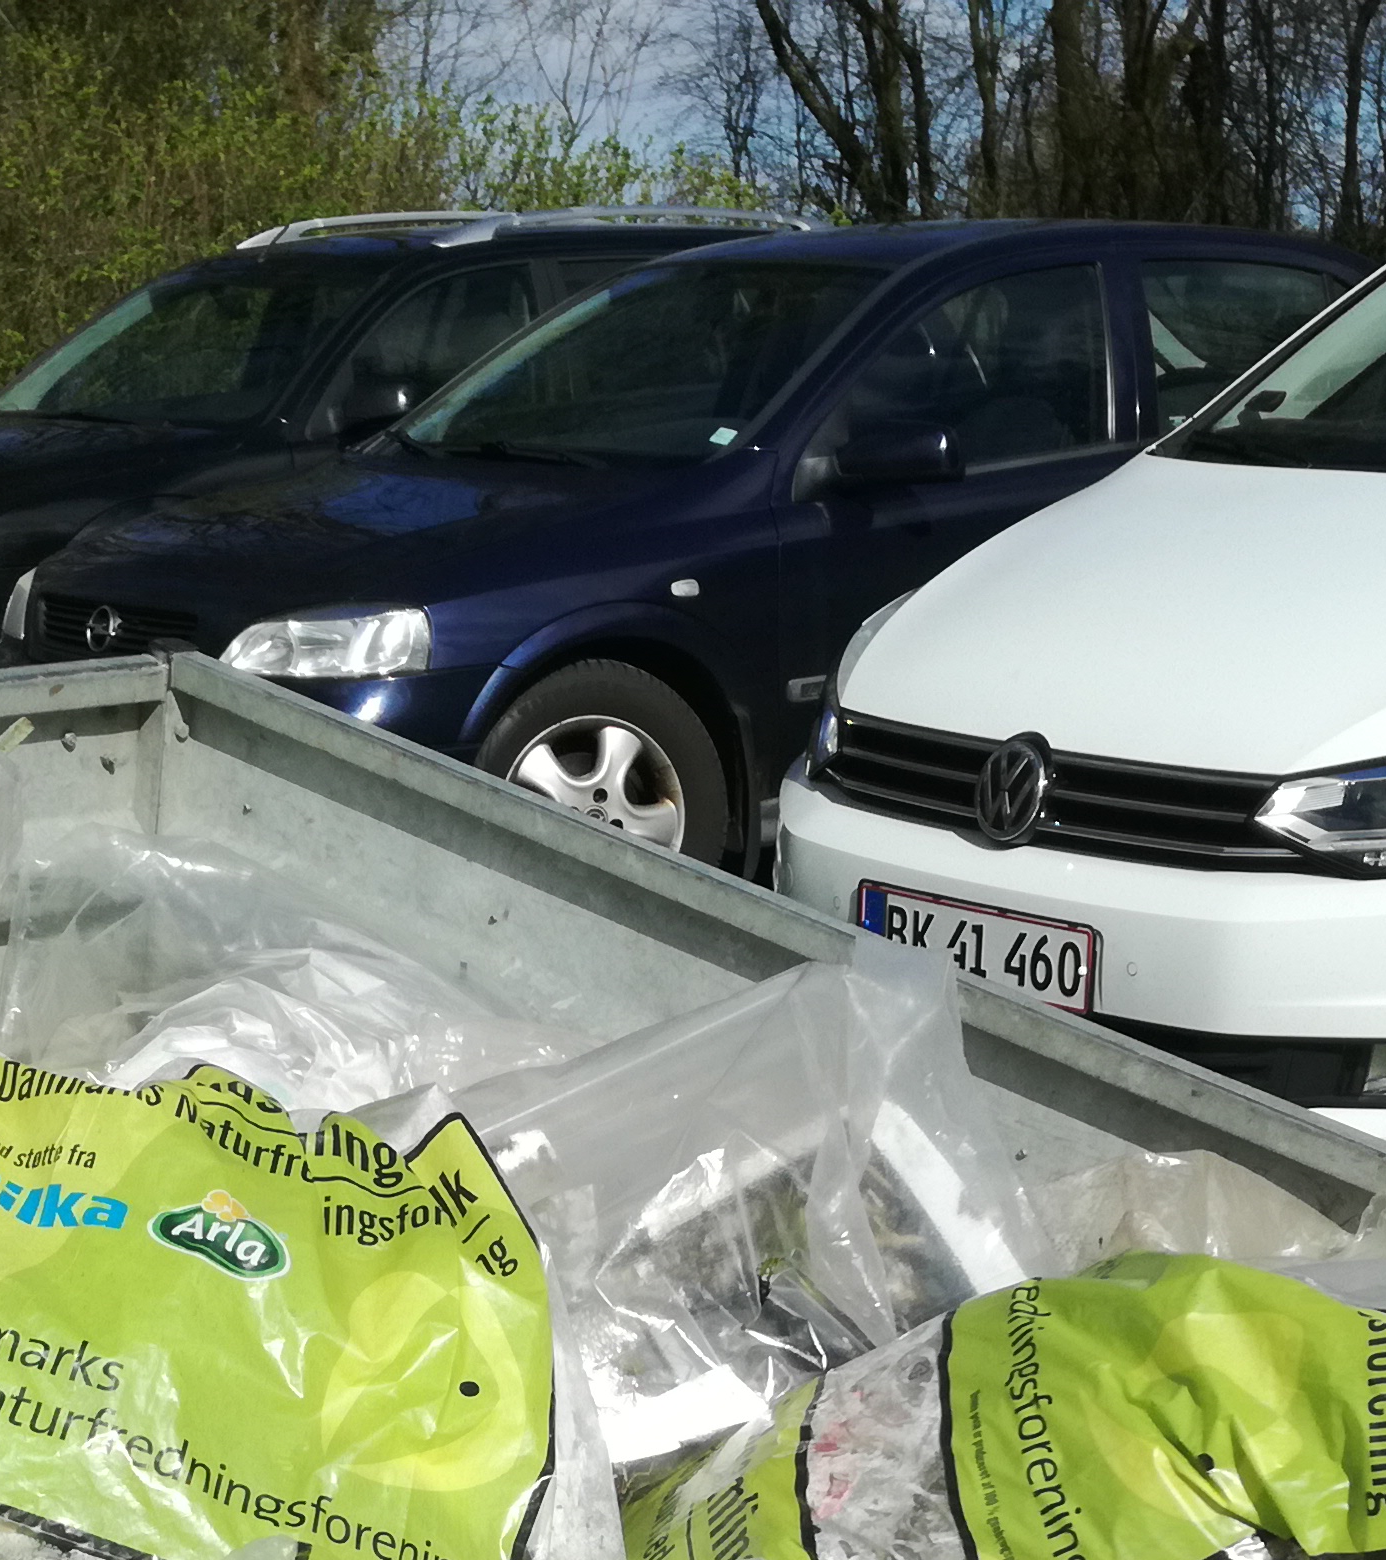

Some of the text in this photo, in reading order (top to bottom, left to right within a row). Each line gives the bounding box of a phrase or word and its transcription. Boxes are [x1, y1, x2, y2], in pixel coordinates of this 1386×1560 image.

[886, 904, 1083, 998] BK 41 460
[13, 1142, 62, 1170] støtte
[66, 1143, 97, 1170] fra
[170, 1212, 270, 1269] Arla
